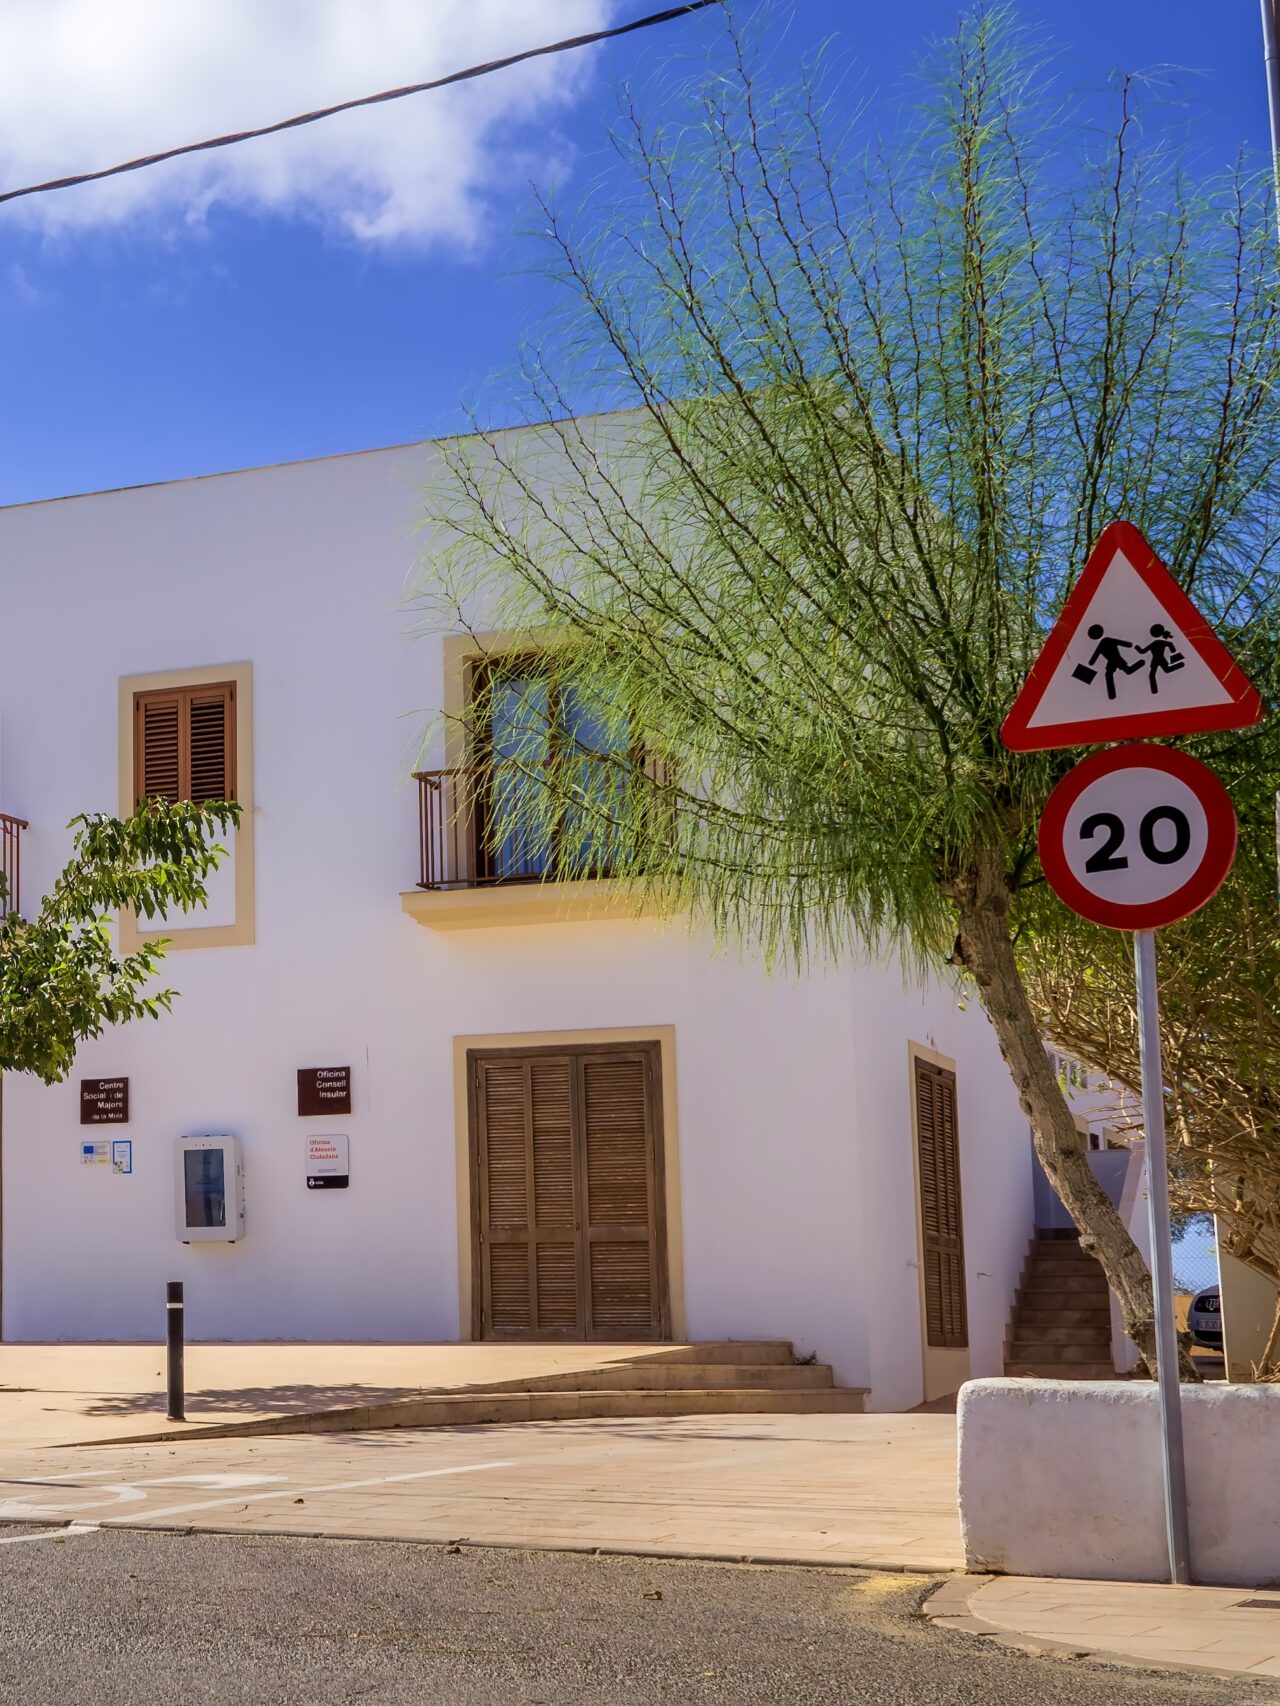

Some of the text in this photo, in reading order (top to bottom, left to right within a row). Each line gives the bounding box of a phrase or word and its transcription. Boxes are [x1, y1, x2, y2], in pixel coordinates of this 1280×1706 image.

[1079, 805, 1191, 874] 20
[317, 1070, 346, 1078] Oficina
[99, 1081, 124, 1090] Centre
[316, 1080, 346, 1088] Consell
[83, 1092, 106, 1100] Social
[319, 1090, 347, 1098] Insular
[97, 1101, 123, 1109] Majors
